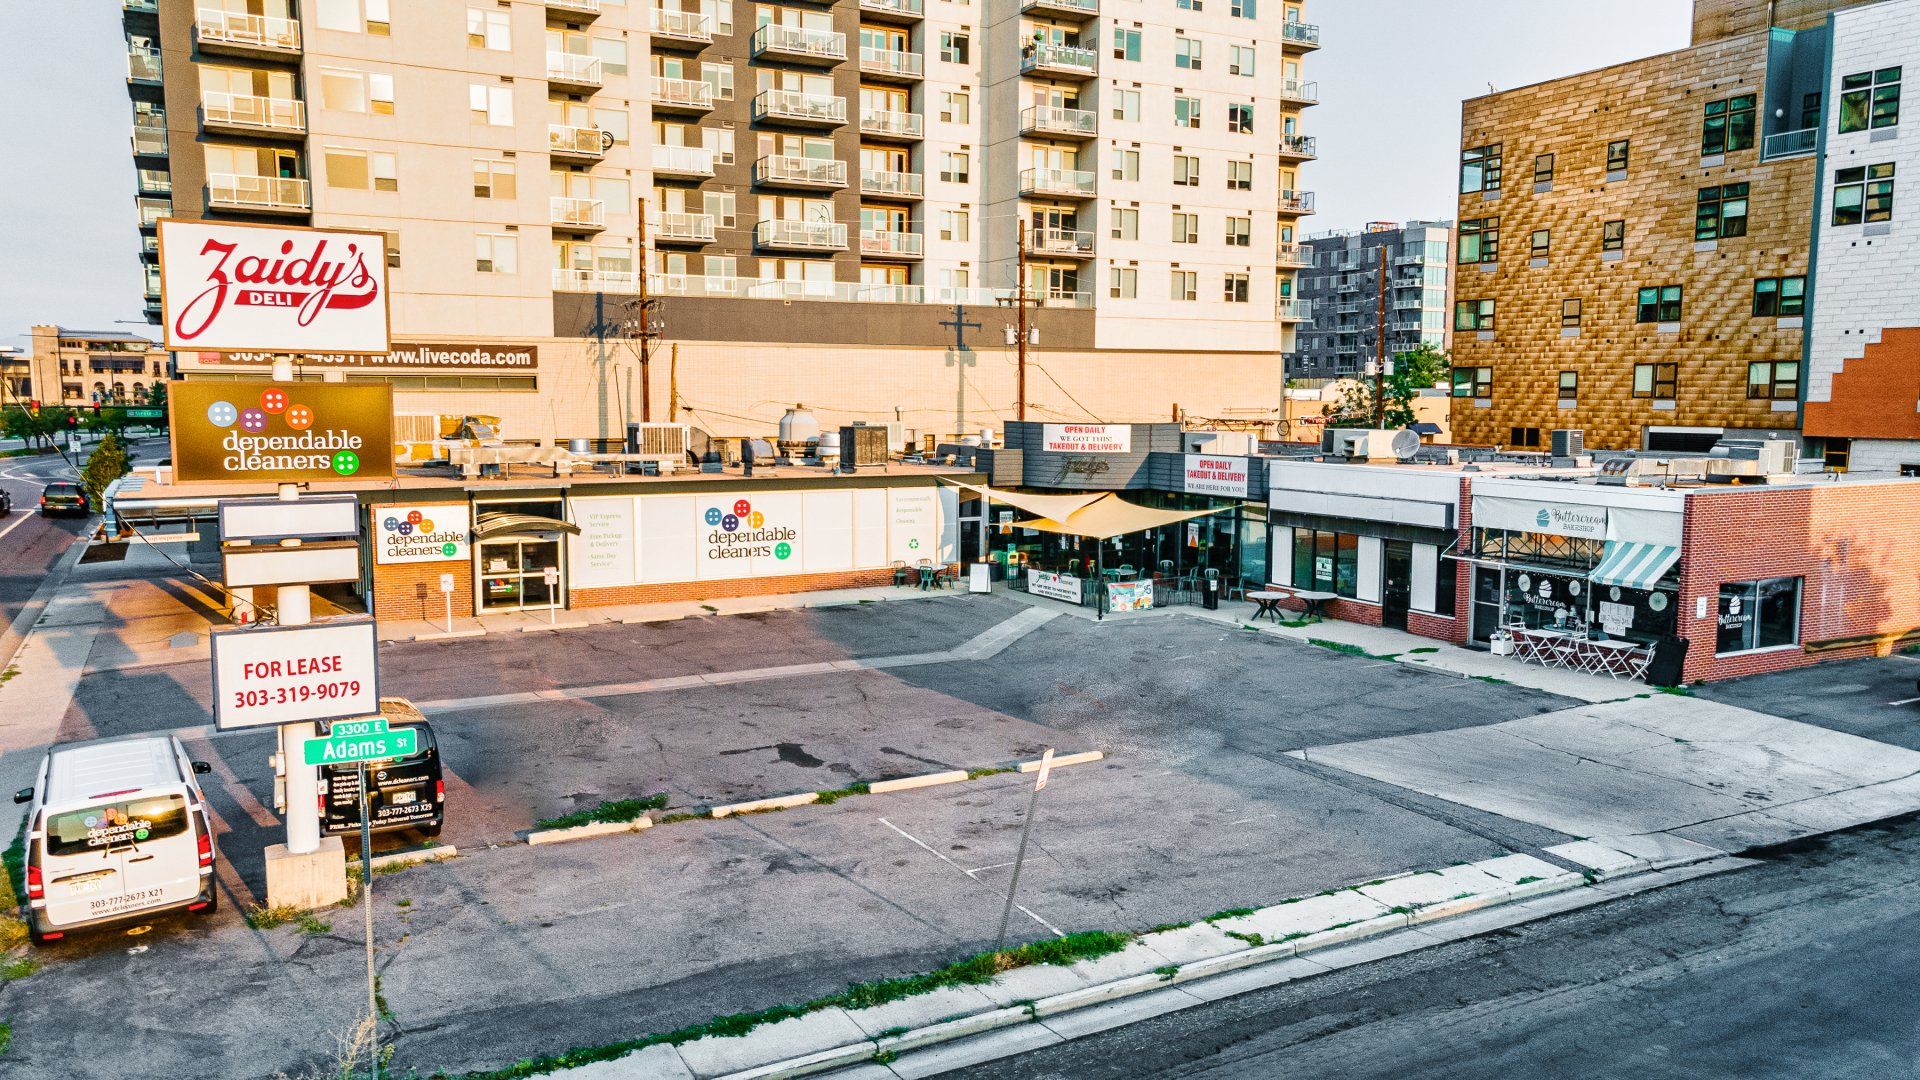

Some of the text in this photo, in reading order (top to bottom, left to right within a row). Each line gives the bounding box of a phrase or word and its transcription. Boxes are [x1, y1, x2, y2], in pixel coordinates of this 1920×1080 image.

[175, 238, 378, 340] Zaidy's
[249, 292, 293, 307] DELI
[1064, 425, 1106, 434] OPEN DAILY
[223, 429, 363, 456] dependable
[1049, 442, 1079, 451] TAKEOUT
[1088, 443, 1123, 451] DELIVERY
[223, 449, 331, 471] cleaners
[1199, 460, 1232, 470] OPEN DAILY
[1186, 470, 1246, 482] TAKEOUT & DELIVERY
[1562, 523, 1595, 533] BAKESHOP
[387, 531, 464, 547] dependable
[708, 527, 796, 547] dependable
[387, 545, 442, 557] cleaners
[708, 544, 771, 560] cleaners
[1522, 592, 1567, 609] Buttercream
[243, 655, 342, 680] FOR LEASE
[235, 680, 361, 709] 303-319-9079
[337, 721, 382, 736] 3300 E
[323, 737, 408, 760] Adams St
[378, 806, 419, 818] 303-777-2673
[87, 819, 152, 838] dependable
[87, 832, 134, 847] cleaners
[90, 888, 163, 909] 303-777-2673 X21
